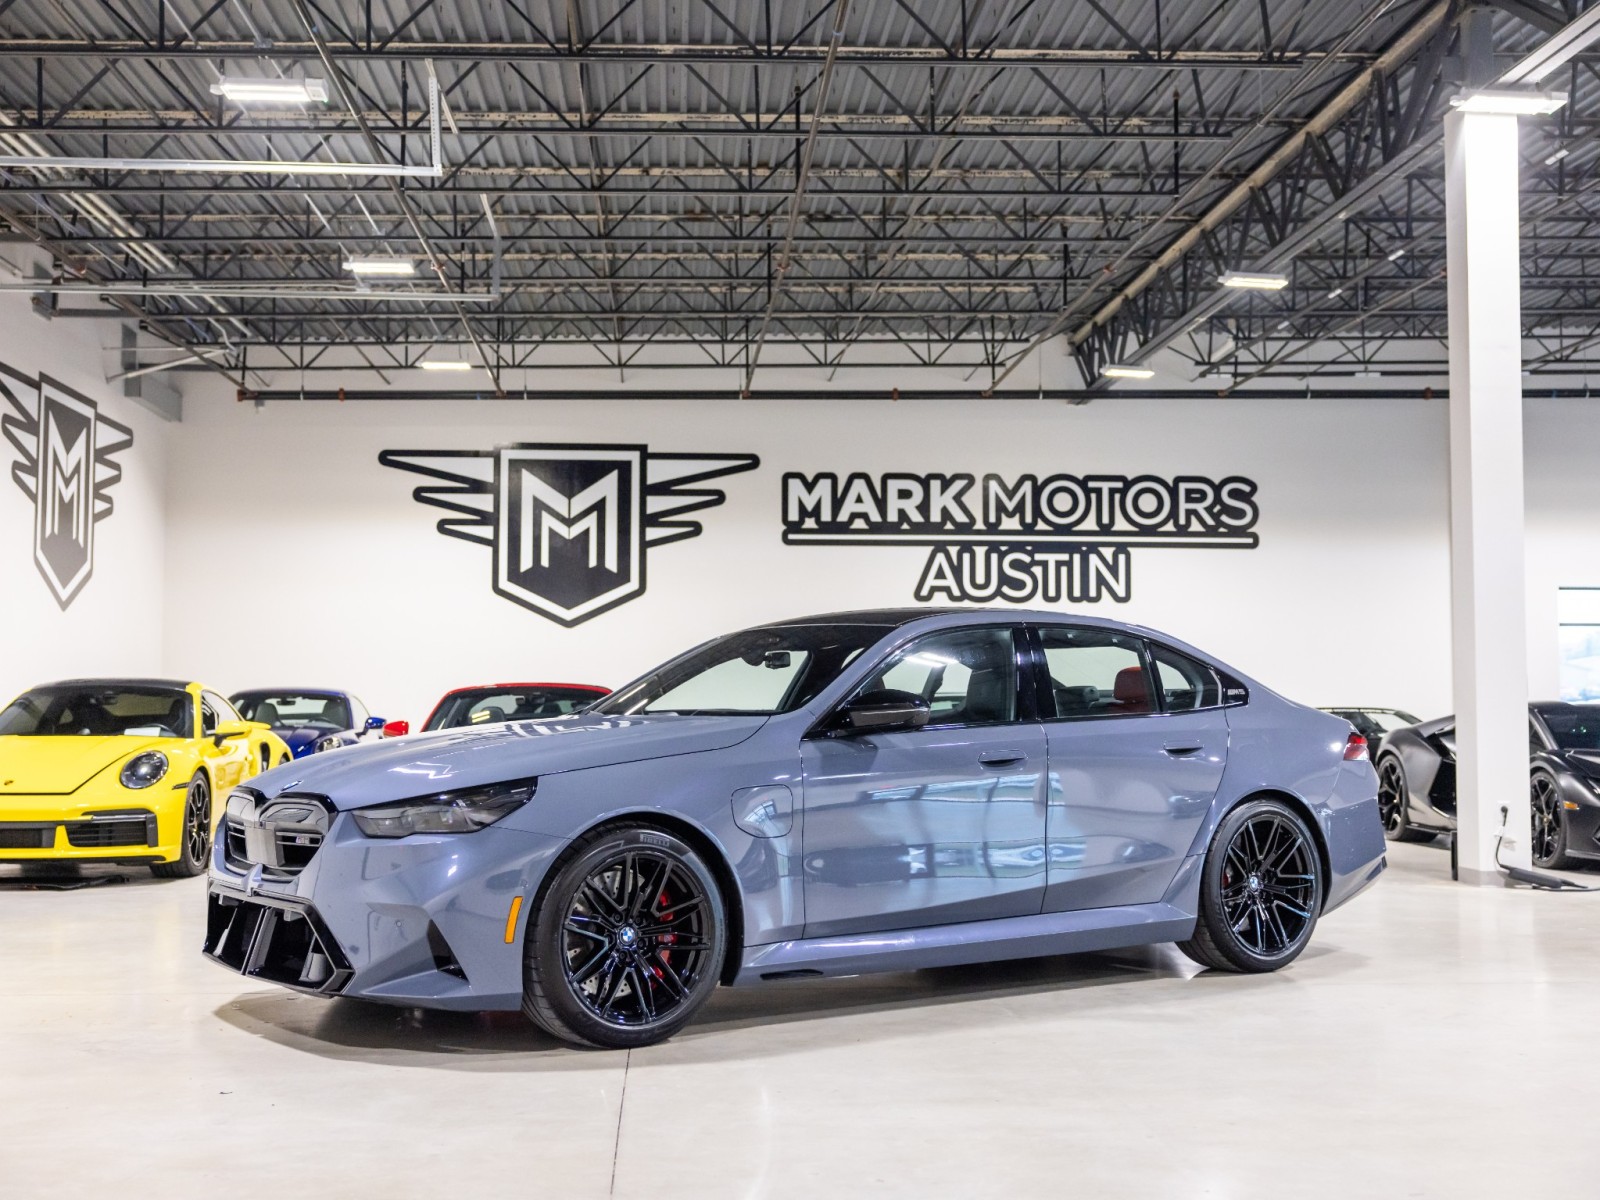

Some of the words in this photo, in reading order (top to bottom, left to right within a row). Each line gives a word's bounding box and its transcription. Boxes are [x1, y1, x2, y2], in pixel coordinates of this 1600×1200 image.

[784, 474, 975, 526] MARK
[984, 475, 1257, 529] MOTORS
[916, 549, 1130, 601] AUSTIN
